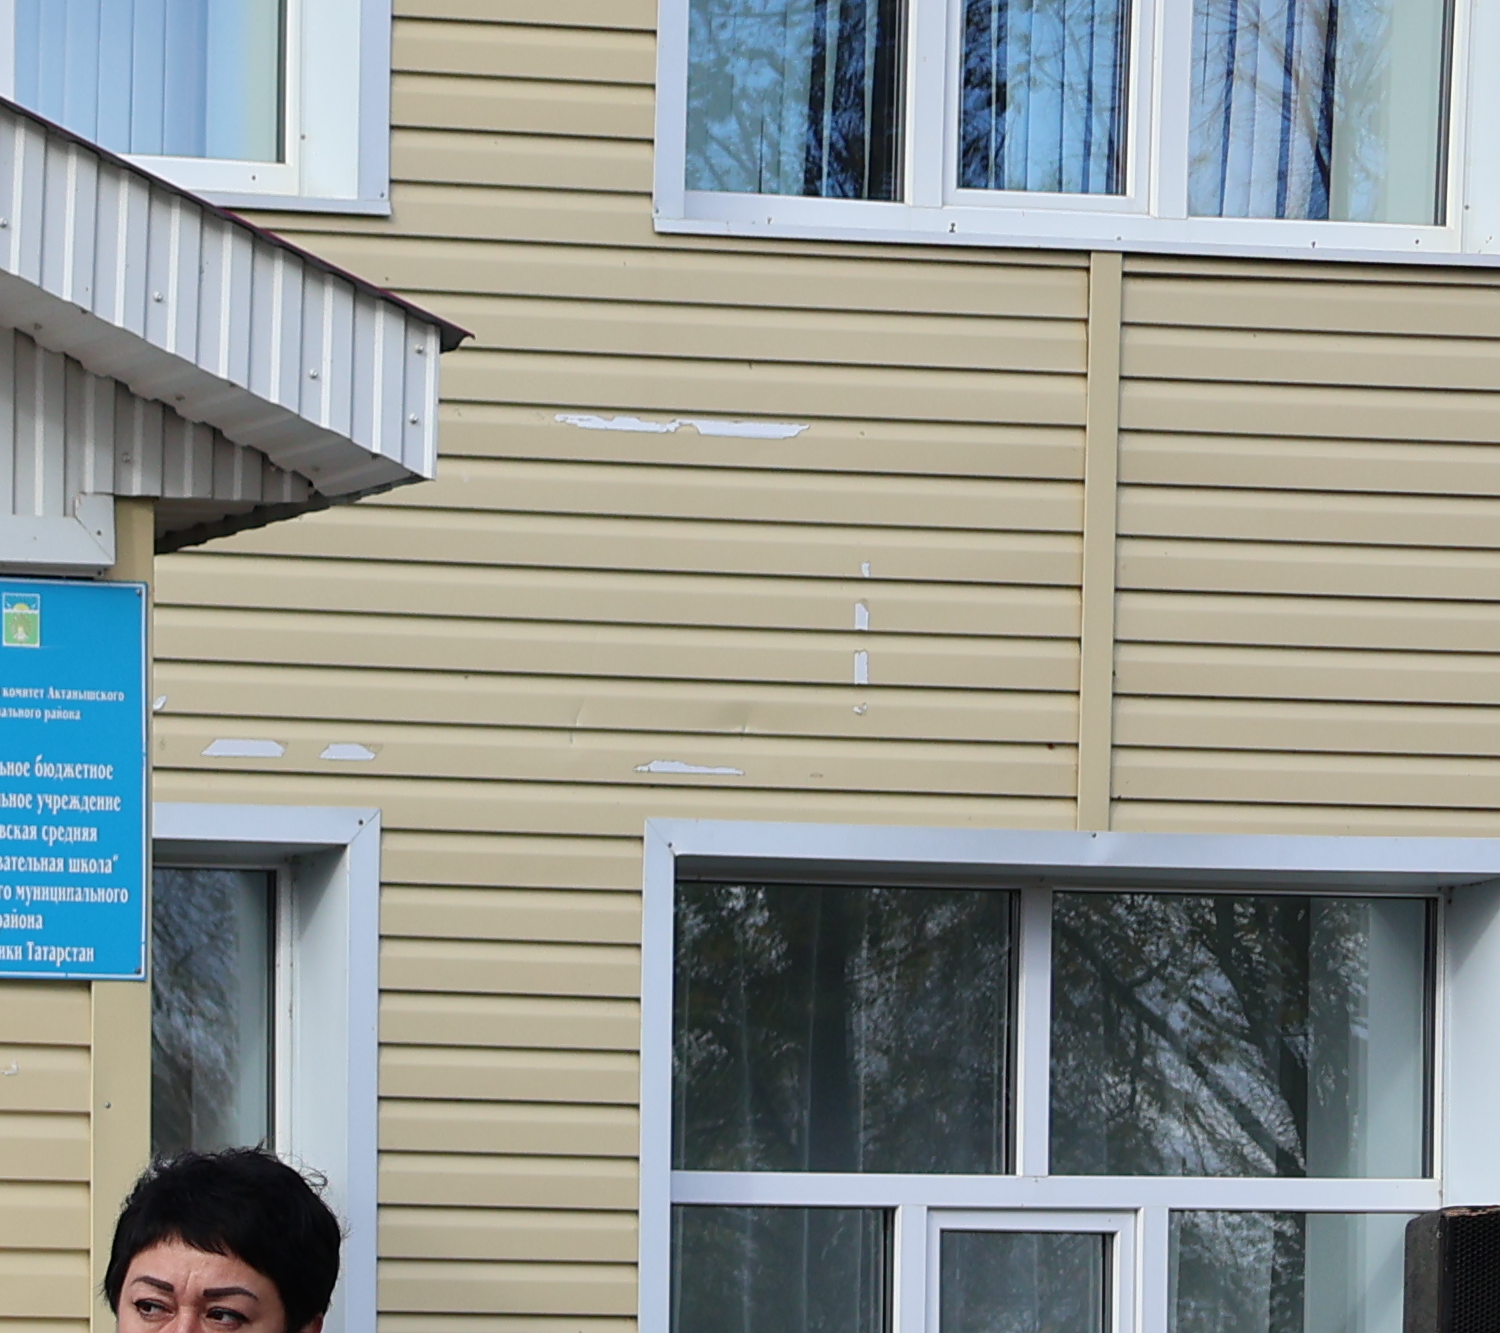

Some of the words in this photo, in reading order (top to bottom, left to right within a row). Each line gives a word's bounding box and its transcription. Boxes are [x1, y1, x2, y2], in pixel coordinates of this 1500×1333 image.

[2, 688, 45, 700] комитет
[48, 686, 125, 702] Актанышского
[44, 706, 81, 723] района
[34, 754, 114, 781] бюджетное
[37, 794, 122, 815] учреждение
[41, 826, 98, 847] средняя
[15, 886, 129, 906] муниципального
[26, 941, 95, 967] Татарстан
